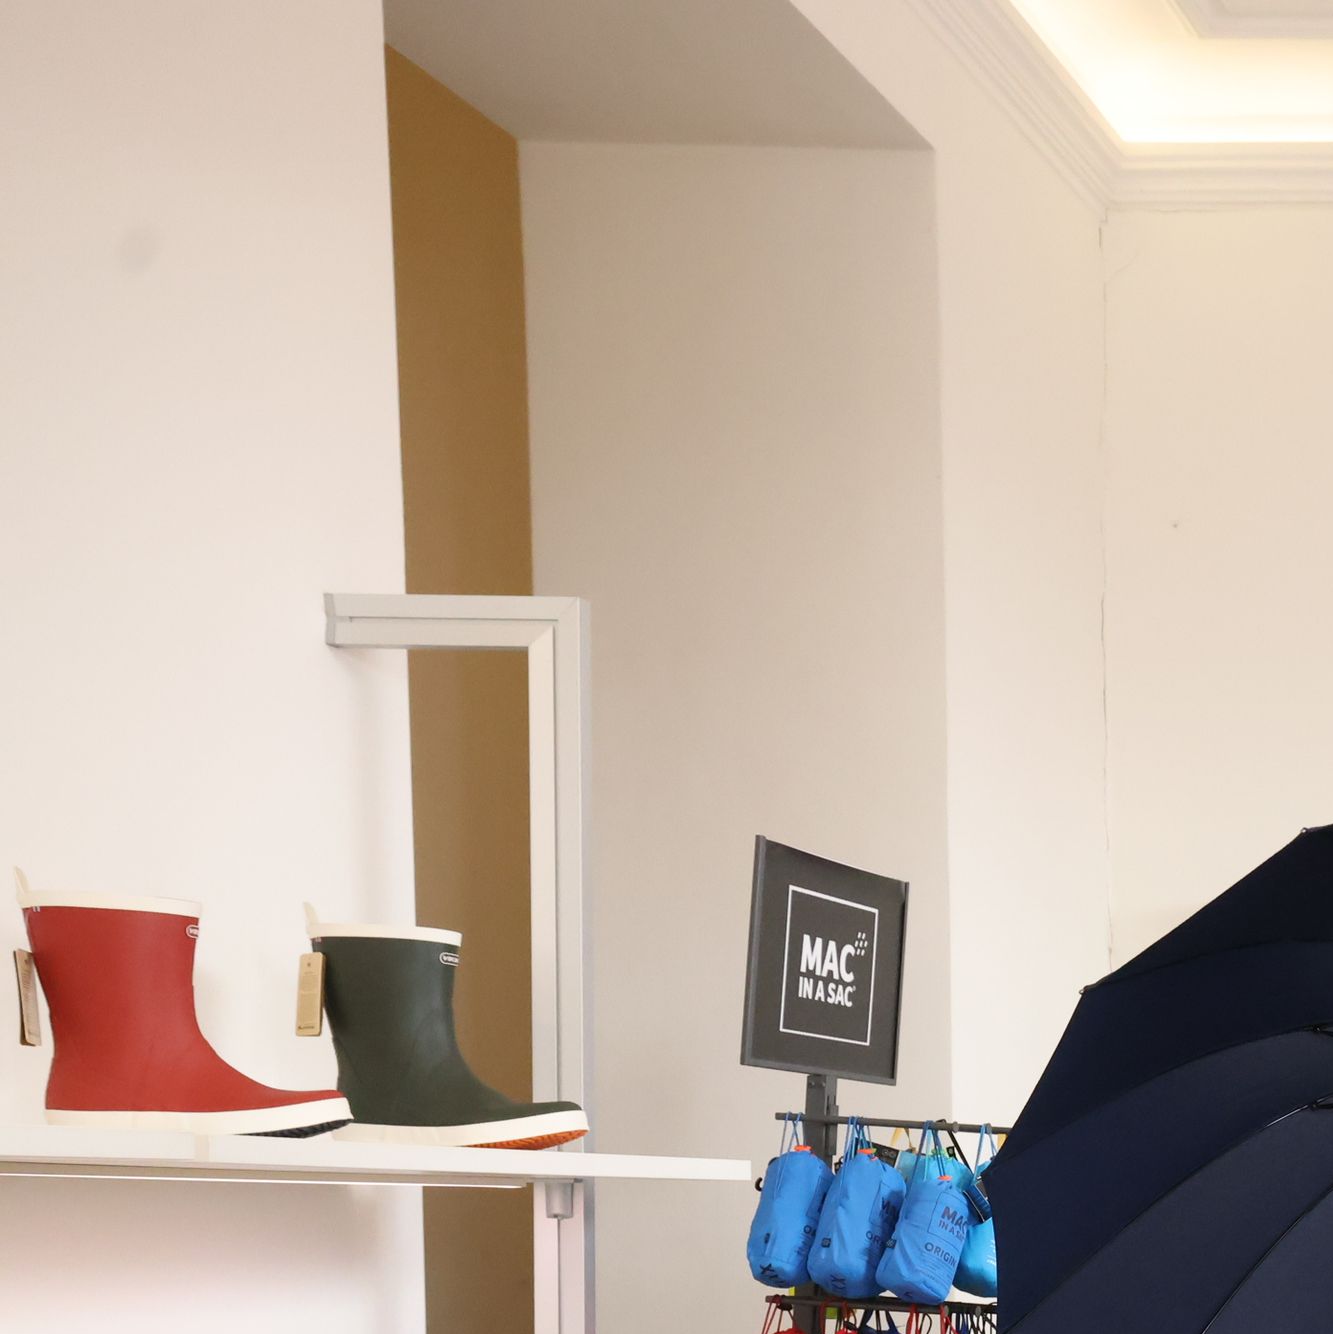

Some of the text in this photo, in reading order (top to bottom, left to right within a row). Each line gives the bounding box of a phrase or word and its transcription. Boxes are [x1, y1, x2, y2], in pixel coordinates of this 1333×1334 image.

[800, 934, 855, 983] MAC
[798, 976, 813, 1000] IN
[814, 980, 825, 1003] A
